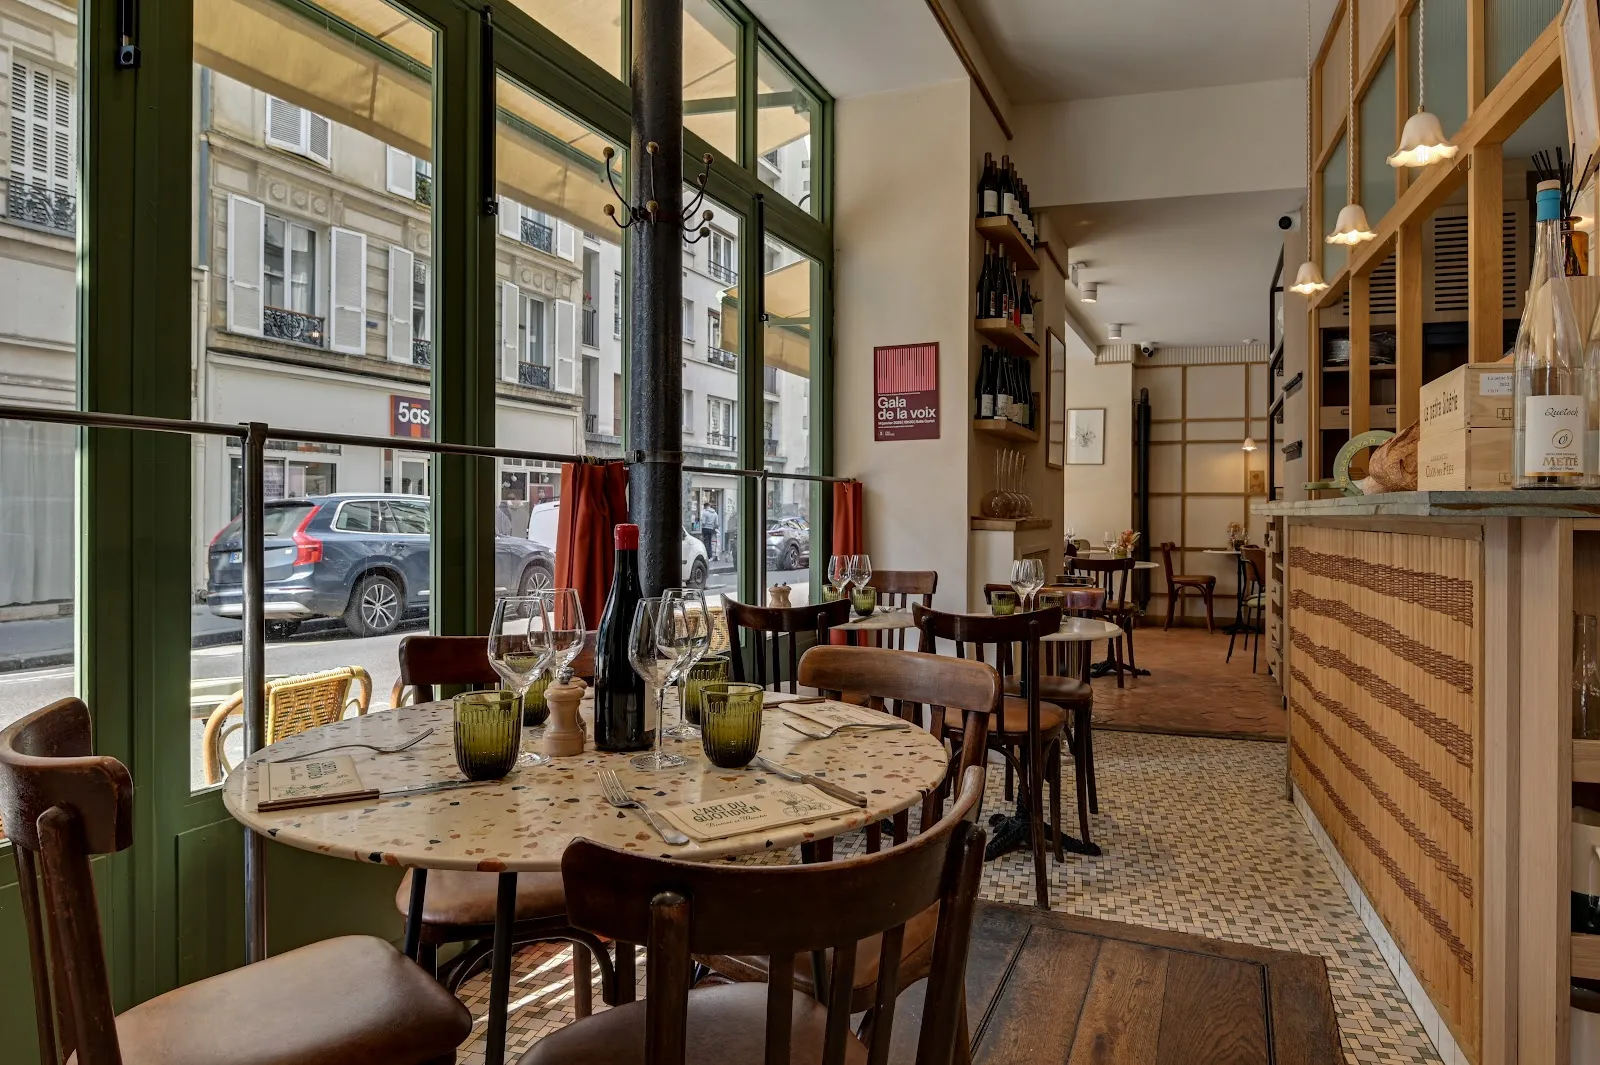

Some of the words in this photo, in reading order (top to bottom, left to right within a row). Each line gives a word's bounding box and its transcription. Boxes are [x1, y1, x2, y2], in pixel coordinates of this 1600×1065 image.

[877, 396, 907, 409] Gala
[877, 408, 894, 420] de
[896, 407, 908, 420] la
[909, 406, 936, 418] voix
[1340, 438, 1376, 472] RAADVAD
[691, 804, 726, 816] L'ART
[727, 800, 747, 810] DU
[693, 805, 762, 823] QUOTIDIEN
